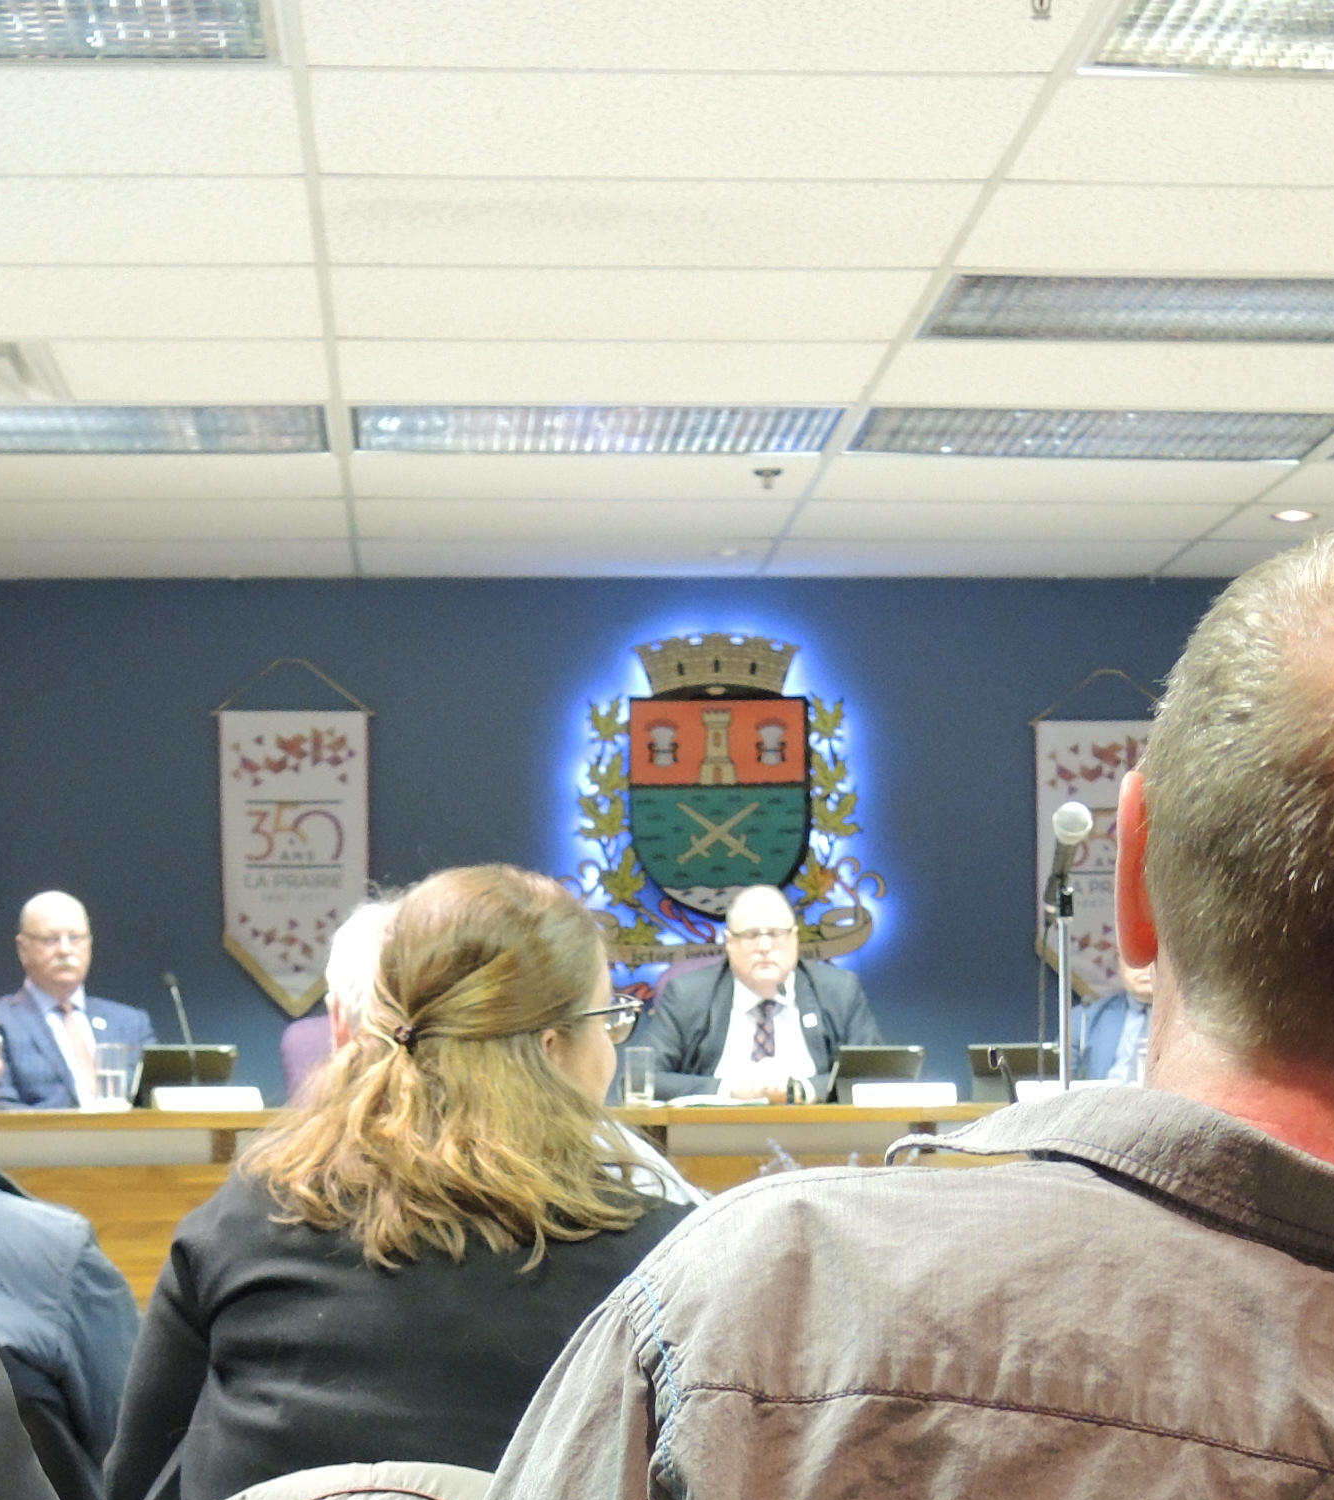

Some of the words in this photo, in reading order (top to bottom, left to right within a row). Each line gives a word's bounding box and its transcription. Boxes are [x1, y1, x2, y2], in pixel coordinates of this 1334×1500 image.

[244, 802, 345, 862] 350
[244, 874, 267, 888] LA
[272, 873, 343, 889] PRAIRIE
